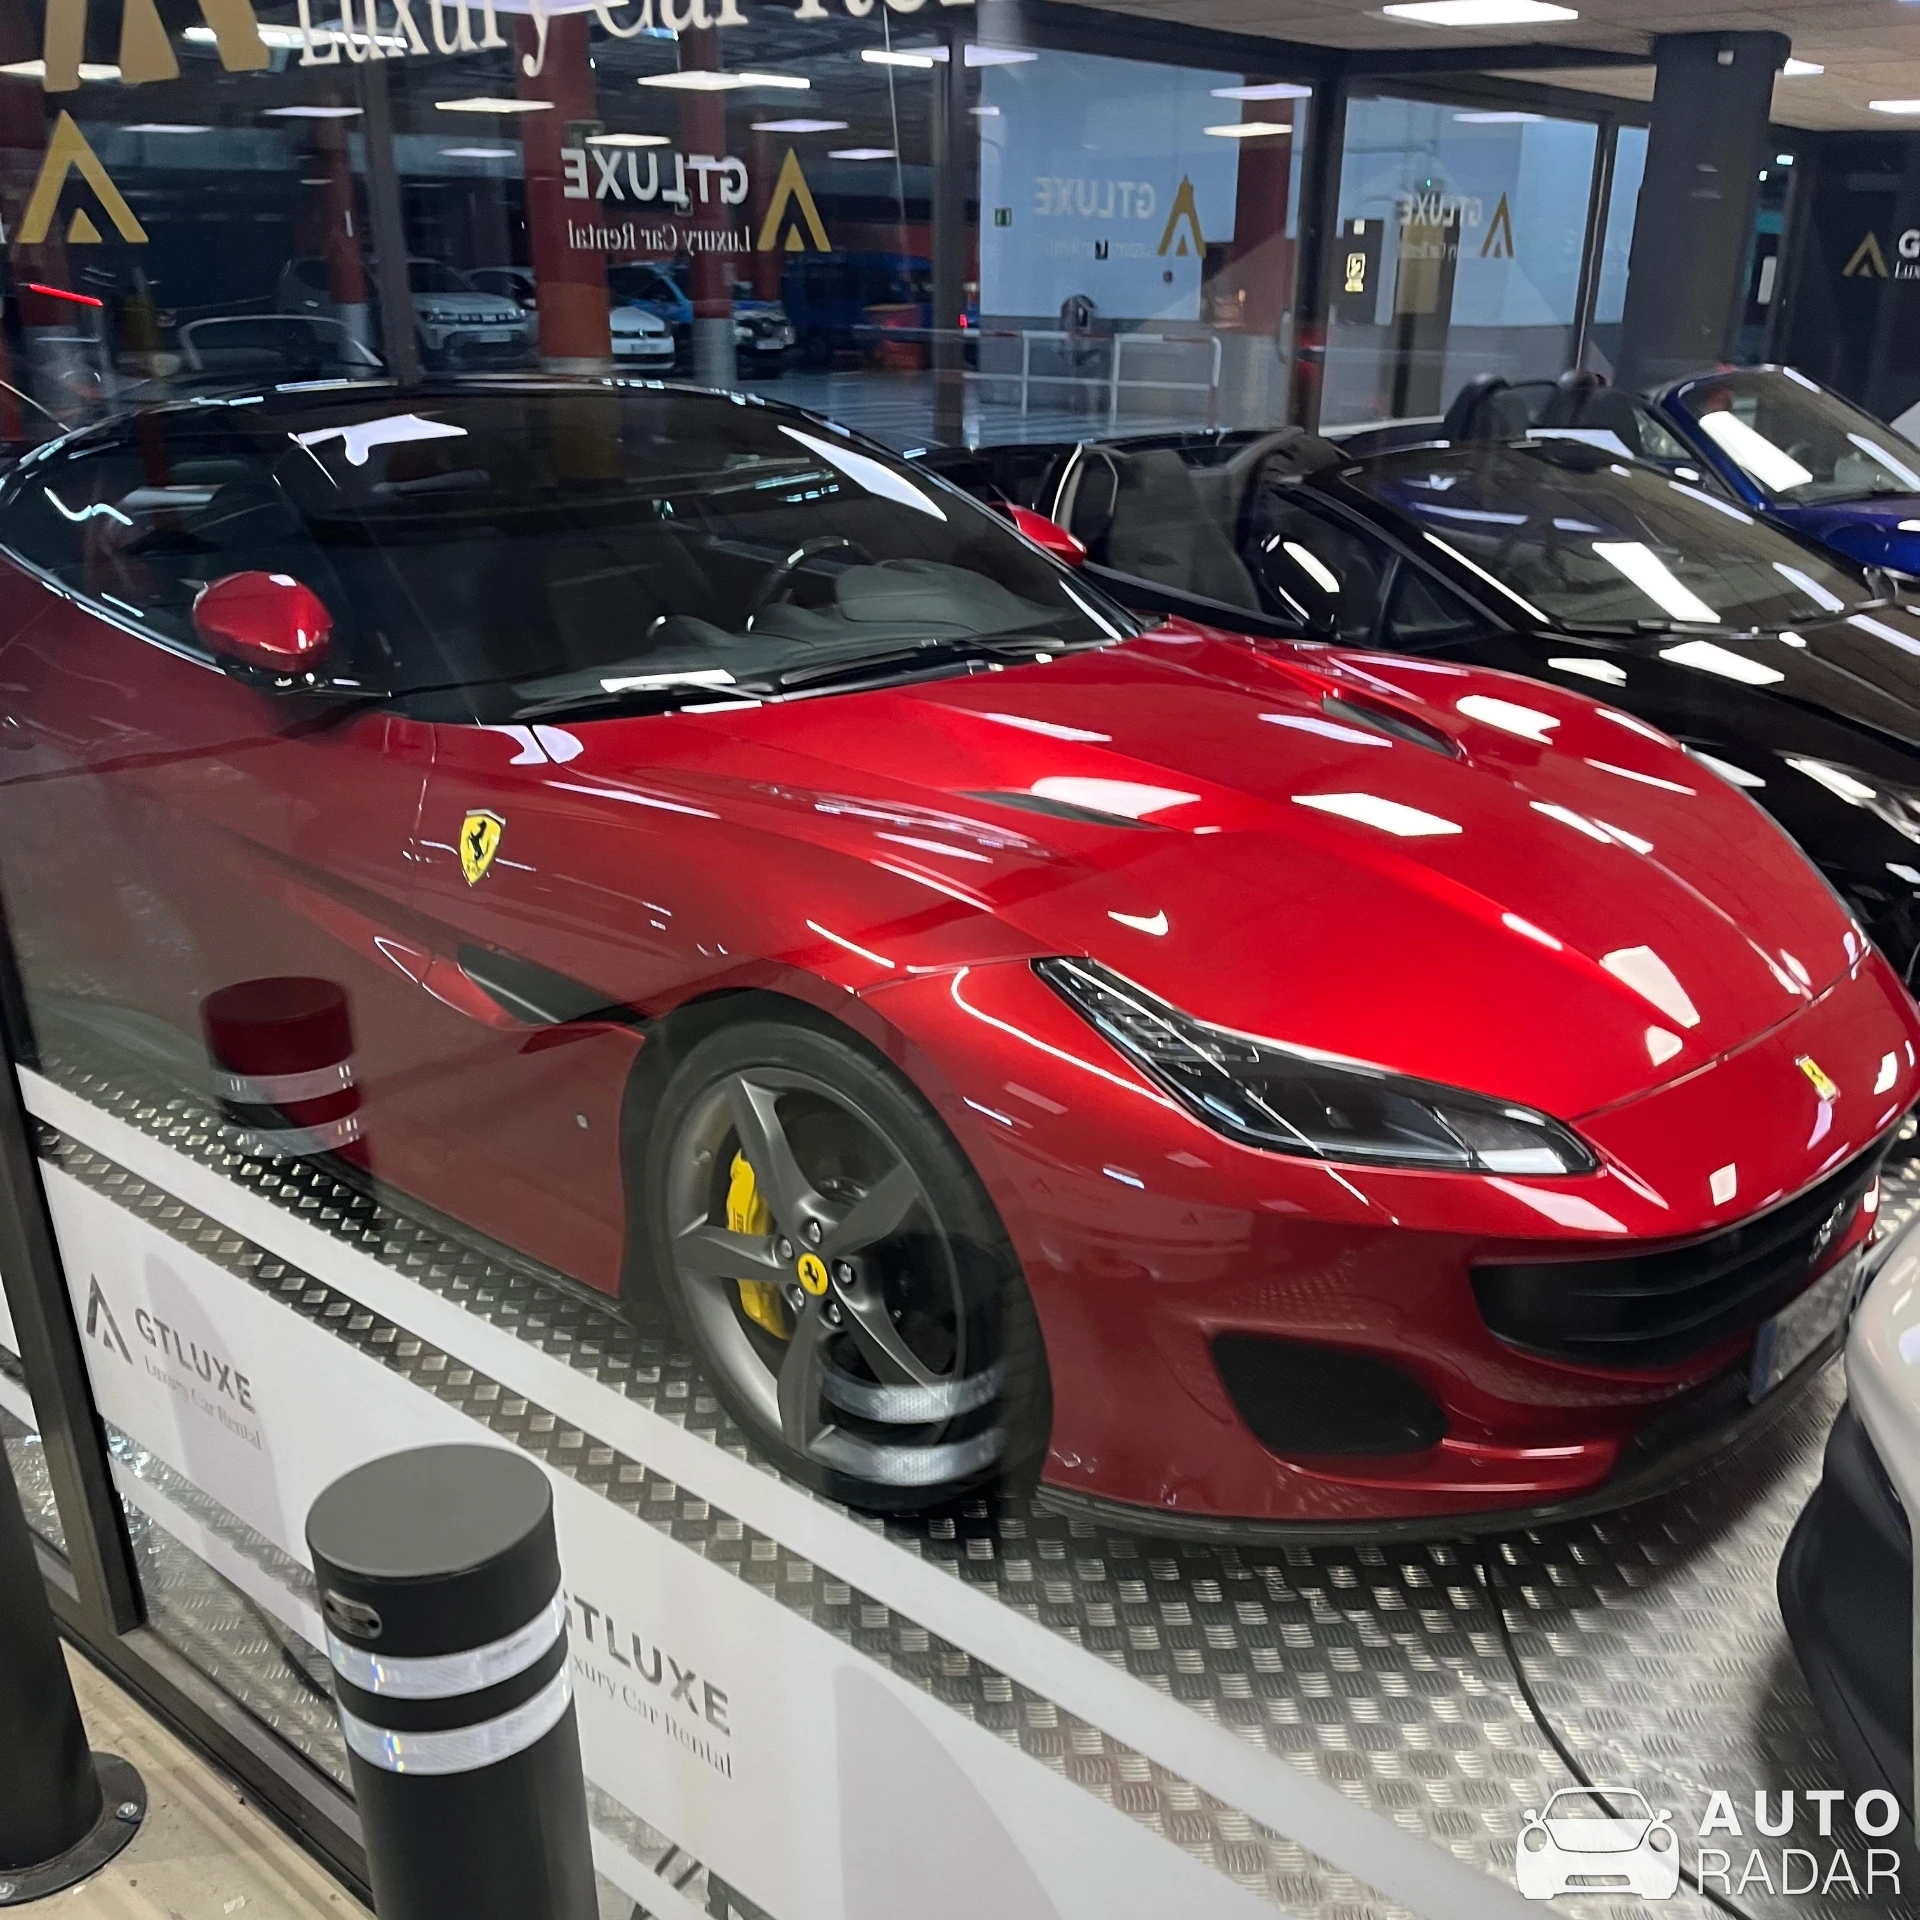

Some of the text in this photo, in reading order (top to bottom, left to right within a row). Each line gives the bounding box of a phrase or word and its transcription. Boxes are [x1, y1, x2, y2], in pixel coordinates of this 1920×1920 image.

[135, 1308, 256, 1415] GTLUXE
[573, 1653, 732, 1779] xury Car Rental
